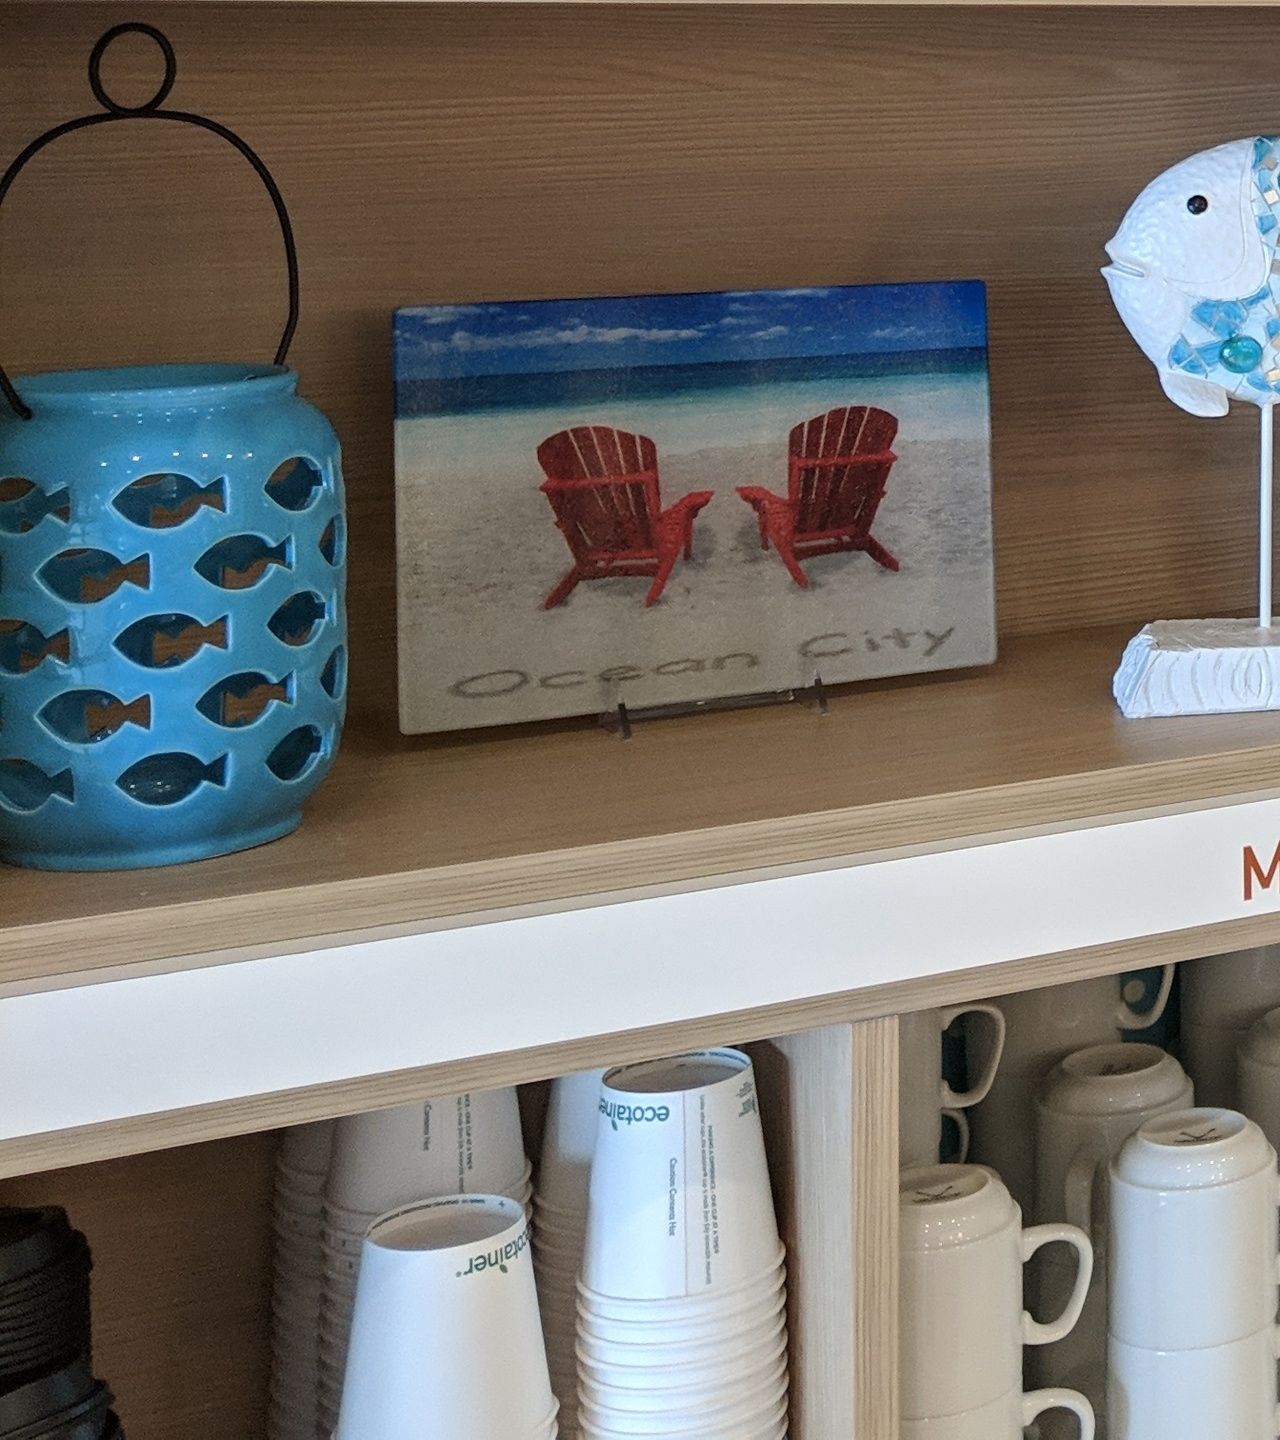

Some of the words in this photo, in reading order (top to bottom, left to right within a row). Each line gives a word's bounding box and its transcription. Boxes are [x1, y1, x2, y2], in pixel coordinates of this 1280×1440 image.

[447, 648, 760, 699] Ocean
[798, 624, 955, 659] City
[599, 1098, 670, 1131] ecotaine
